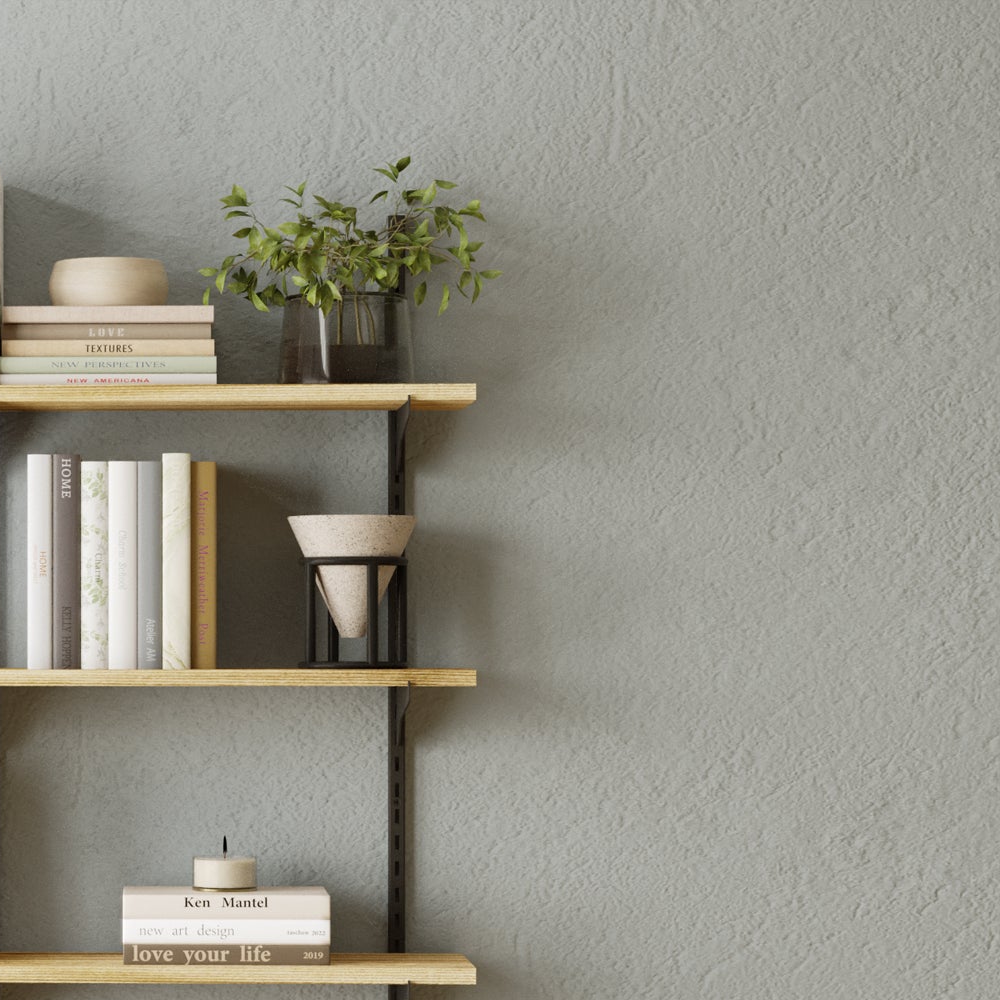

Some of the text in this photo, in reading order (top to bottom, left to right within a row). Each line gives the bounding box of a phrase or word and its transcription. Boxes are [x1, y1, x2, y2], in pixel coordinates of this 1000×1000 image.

[89, 328, 126, 338] LOVE
[86, 344, 133, 353] TEXTURES
[51, 361, 166, 369] NEW PERSPECTIVES
[61, 458, 72, 498] HOME
[39, 551, 47, 577] HOME
[197, 491, 209, 645] Marjorie Merriweather Post
[61, 606, 72, 634] KELLY
[145, 618, 156, 662] Atelier AM
[184, 896, 269, 908] Ken Mantel
[139, 924, 235, 940] new art design
[132, 945, 272, 966] love your life
[303, 951, 324, 960] 2019
